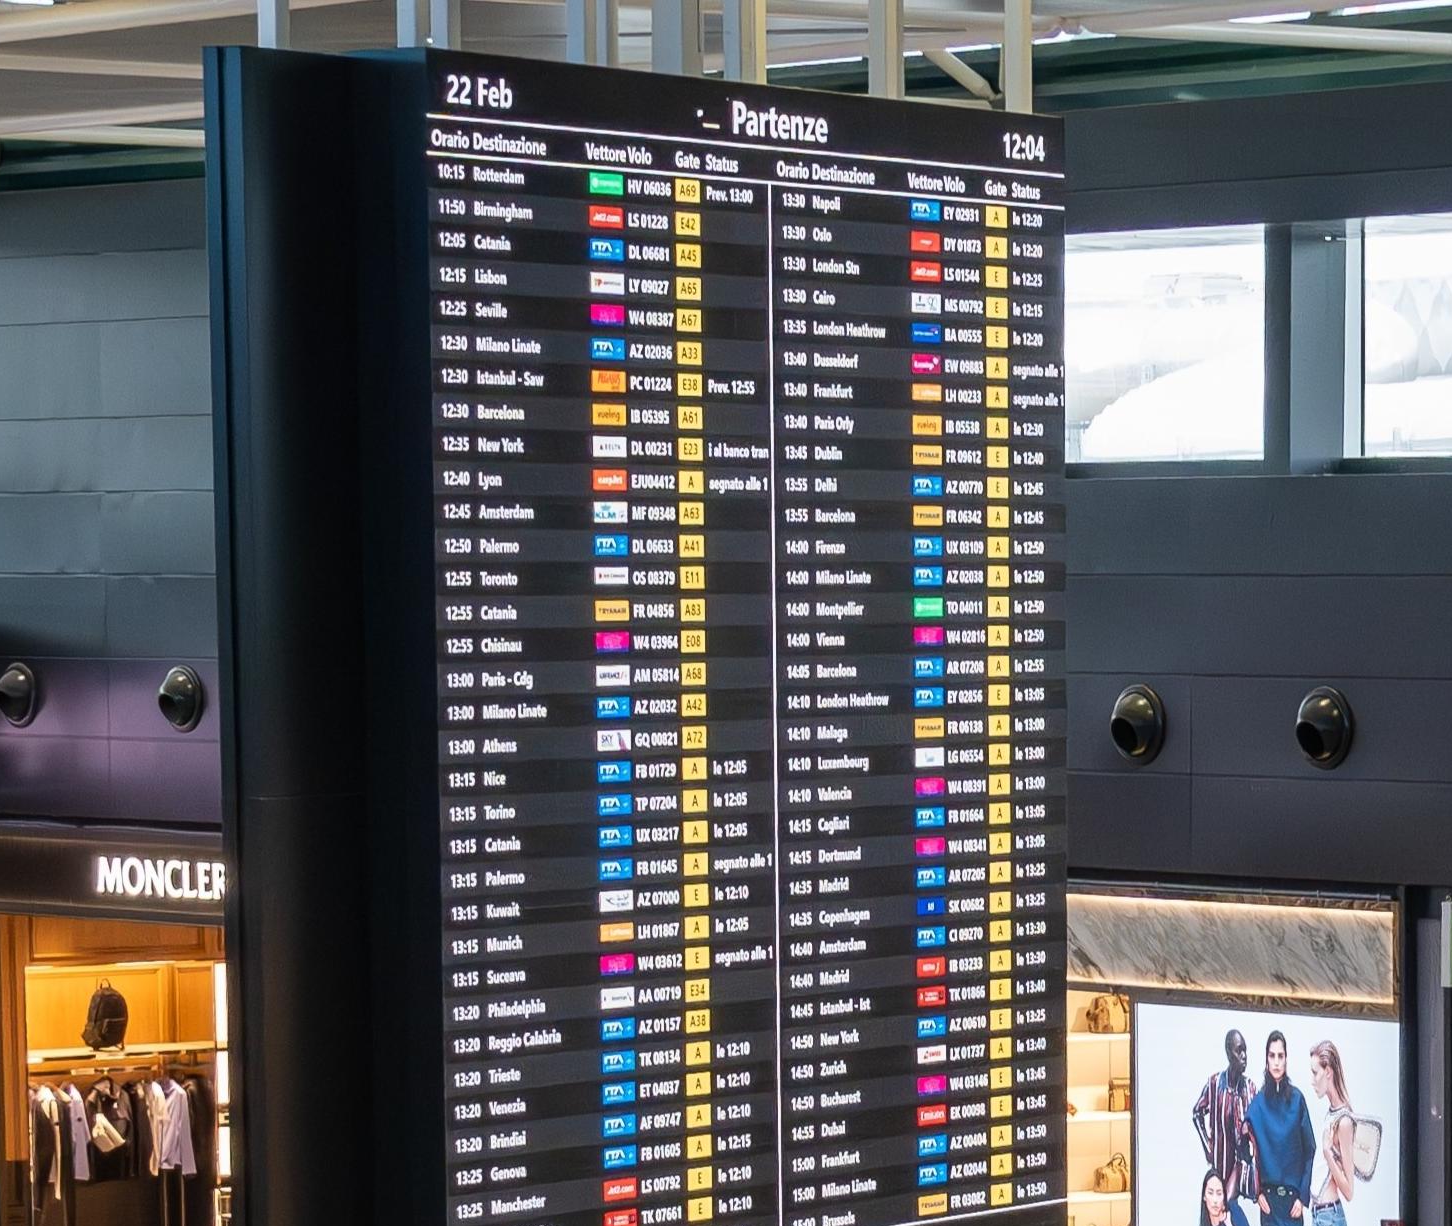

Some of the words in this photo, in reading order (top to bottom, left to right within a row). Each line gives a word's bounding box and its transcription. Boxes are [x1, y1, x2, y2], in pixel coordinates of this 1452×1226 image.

[446, 74, 471, 104] 22
[477, 77, 512, 108] Feb
[732, 100, 828, 143] Partenze
[430, 128, 469, 148] Orario
[472, 132, 546, 155] Destinazione
[584, 142, 626, 162] Vettore
[627, 145, 652, 165] Volo
[674, 150, 700, 169] Gate
[705, 153, 738, 173] Status
[1003, 132, 1045, 161] 12:04
[437, 163, 464, 179] 10:15
[473, 166, 524, 184] Rotterdam
[627, 178, 642, 194] HV
[679, 184, 696, 196] A69
[706, 185, 728, 201] Prev.
[729, 188, 753, 203] 13:00
[776, 160, 809, 179] Orario
[811, 163, 875, 185] Destinazione
[907, 171, 943, 191] Vettore
[943, 175, 965, 193] Volo
[984, 179, 1007, 196] Gate
[1011, 181, 1040, 200] Status
[438, 198, 465, 215] 11:50
[473, 200, 532, 222] Birmingham
[627, 212, 639, 227] LS
[680, 217, 695, 230] E42
[439, 231, 466, 248] 12:05
[473, 234, 510, 250] Catania
[628, 244, 641, 259] DL
[680, 248, 696, 261] A45
[440, 335, 467, 350] 12:30
[475, 336, 510, 352] Milano
[511, 337, 541, 353] Linate
[629, 343, 643, 358] AZ
[681, 347, 697, 359] A33
[97, 857, 225, 899] MONCLER
[453, 1037, 480, 1053] 13:20
[488, 1032, 522, 1053] Reggio
[522, 1028, 561, 1046] Calabria
[638, 1018, 652, 1034] AZ
[690, 1014, 705, 1026] A38
